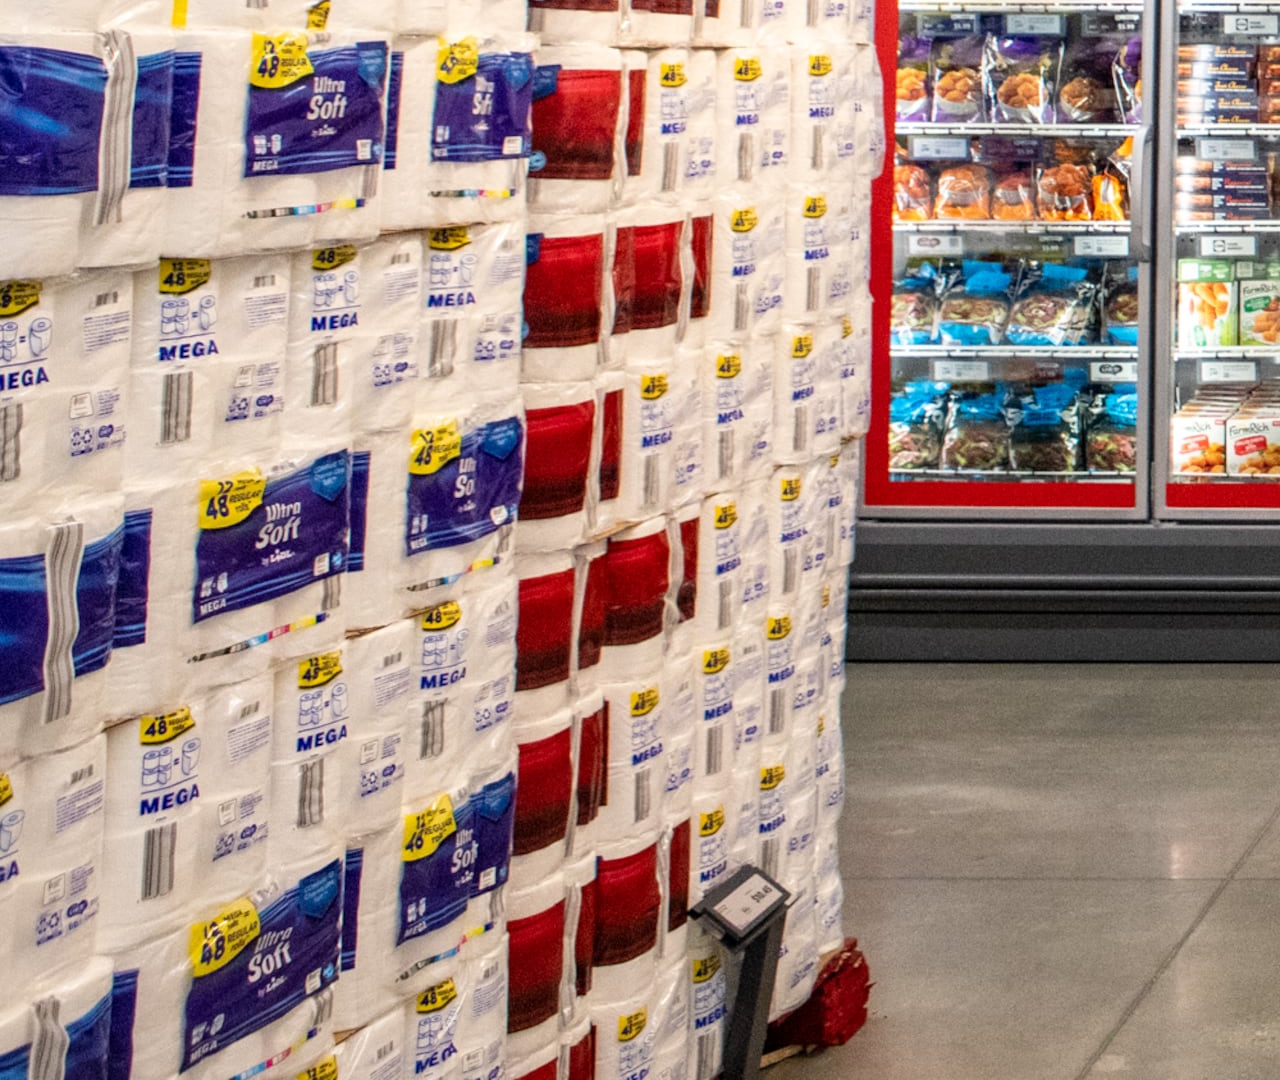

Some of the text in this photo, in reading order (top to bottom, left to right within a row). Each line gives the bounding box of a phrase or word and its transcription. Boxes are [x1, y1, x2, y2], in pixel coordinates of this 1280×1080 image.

[257, 57, 279, 78] 48
[314, 77, 345, 94] Ultra
[307, 95, 347, 120] Soft
[316, 251, 335, 263] 48
[163, 272, 185, 286] 48
[427, 292, 476, 308] MEGA
[311, 312, 358, 331] MEGA
[159, 340, 219, 361] MEGA
[206, 497, 229, 519] 48
[265, 501, 300, 524] Ultra
[256, 517, 300, 550] Soft
[200, 599, 226, 615] MEGA
[425, 610, 441, 624] 48
[420, 667, 467, 690] MEGA
[145, 720, 168, 736] 48
[297, 725, 347, 752] MEGA
[140, 784, 200, 816] MEGA
[227, 921, 258, 944] REGULAR
[254, 927, 293, 953] Ultra
[201, 935, 225, 965] 48
[248, 941, 292, 984] Soft
[421, 991, 437, 1007] 48
